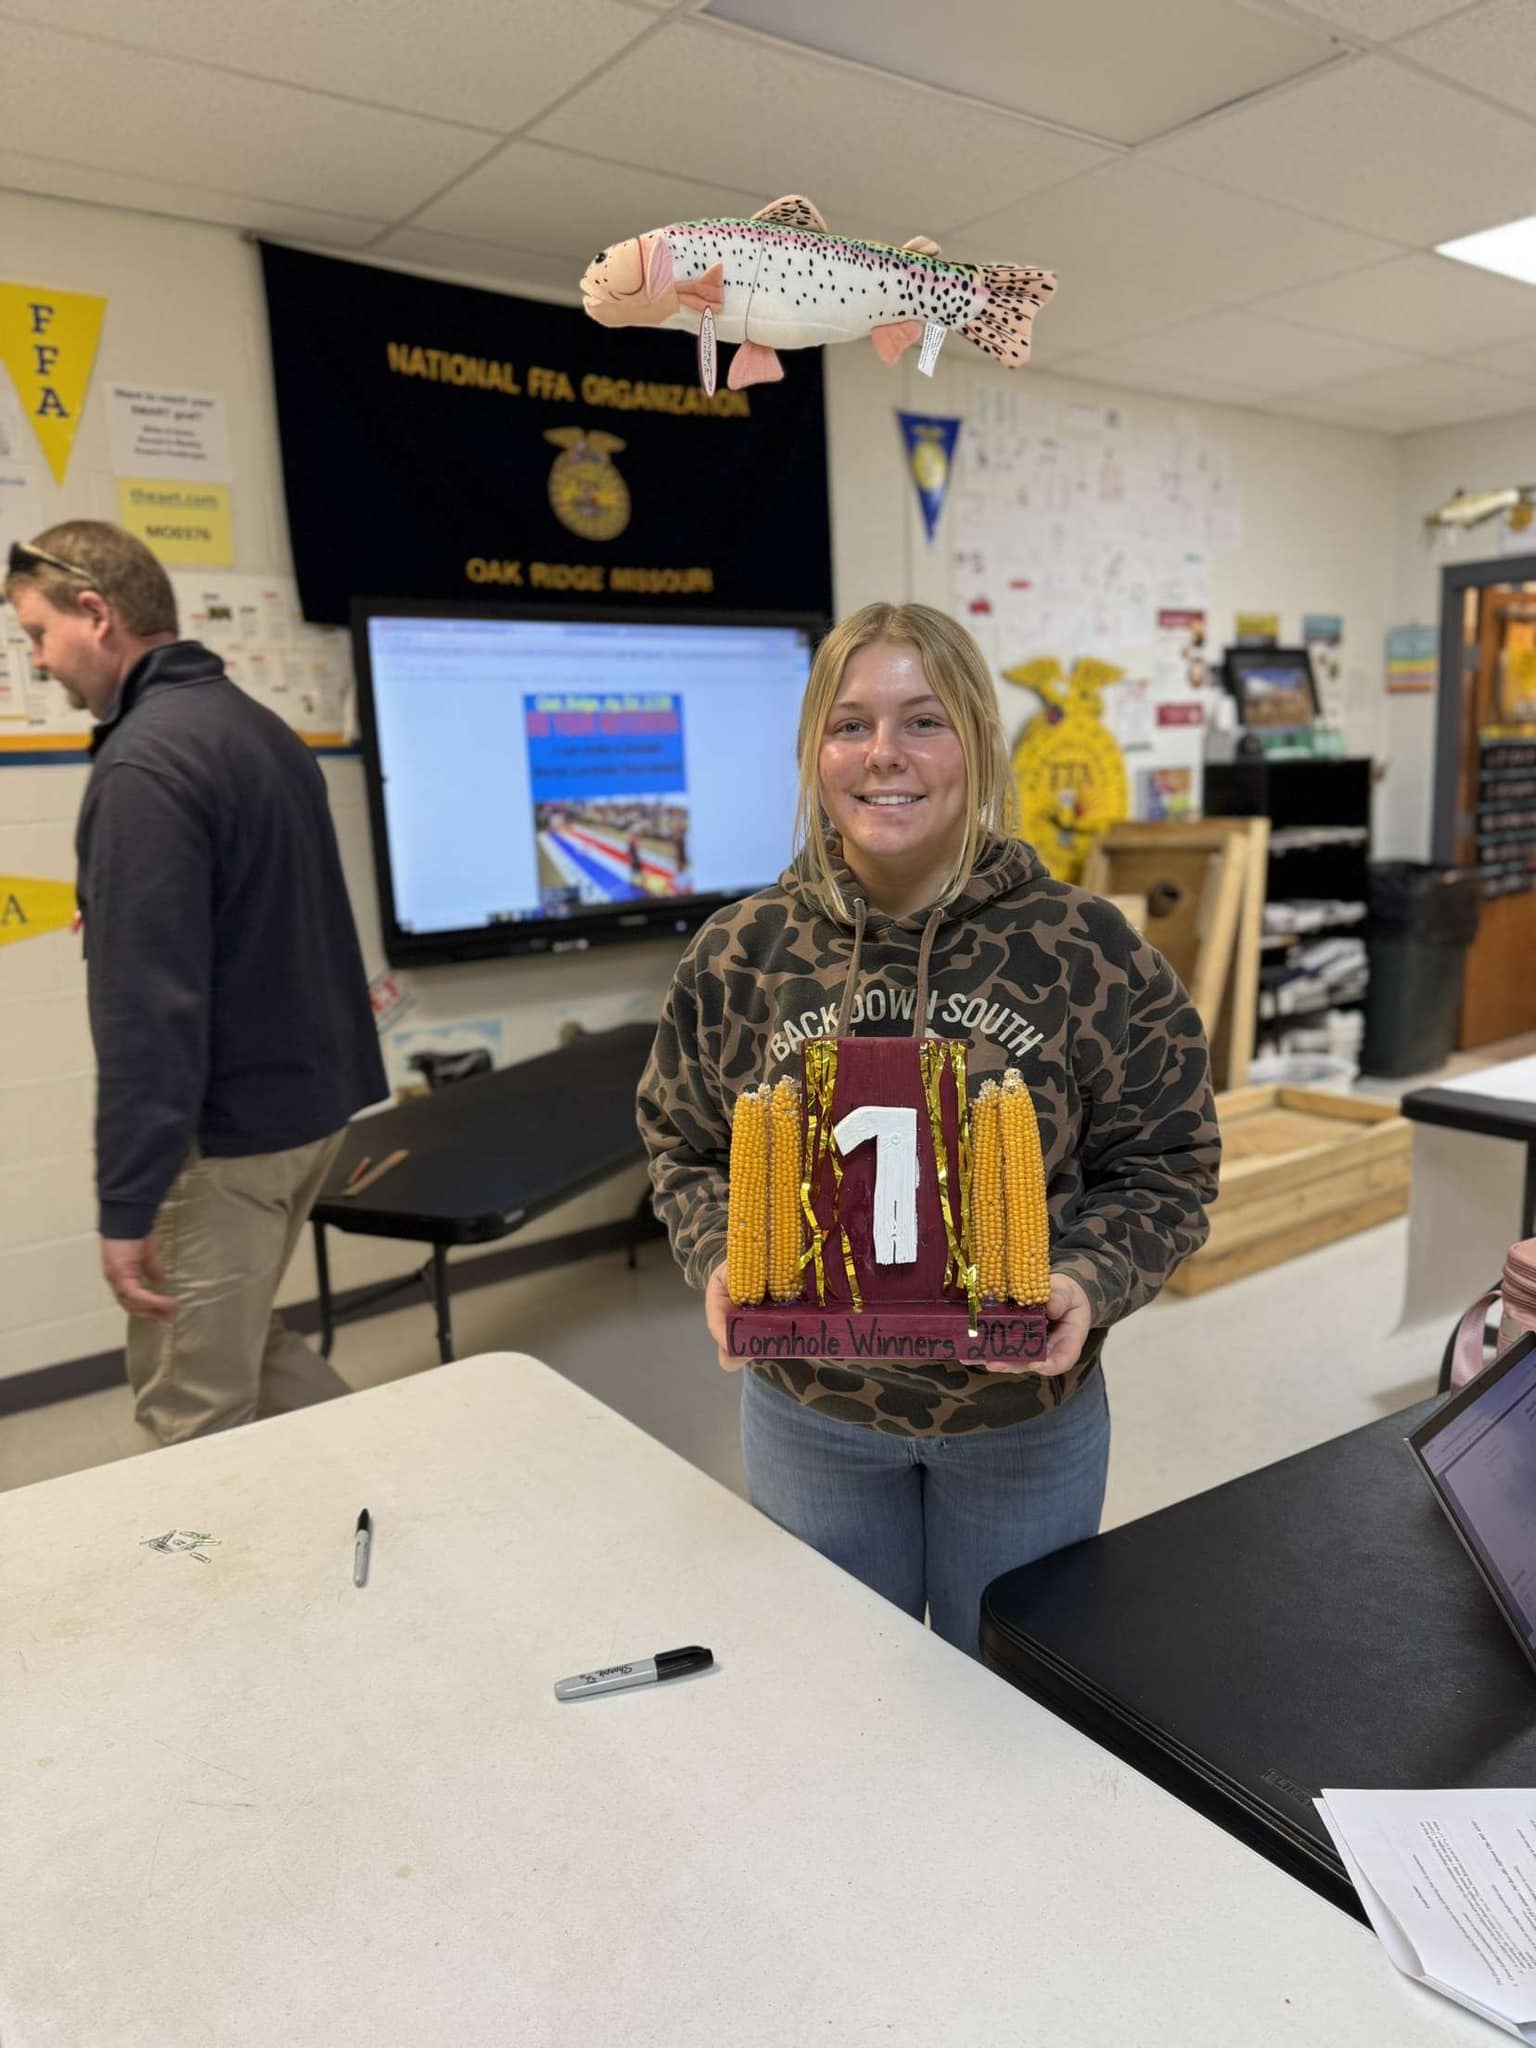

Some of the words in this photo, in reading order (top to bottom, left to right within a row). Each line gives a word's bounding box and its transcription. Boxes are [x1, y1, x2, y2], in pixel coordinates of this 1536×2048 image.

[28, 302, 70, 419] FFA
[387, 341, 521, 396] NATIONAL
[527, 366, 577, 402] FFA
[581, 373, 751, 418] ORGANIZATION
[465, 557, 524, 586] OAK
[530, 562, 605, 592] RIDGE
[610, 567, 714, 594] MISSOURI
[770, 1002, 840, 1062] BACK
[941, 992, 1045, 1058] SOUTH
[832, 1105, 919, 1266] 1
[729, 1317, 841, 1356] Cornhole
[846, 1316, 956, 1359] Winners
[967, 1318, 1045, 1360] 2025
